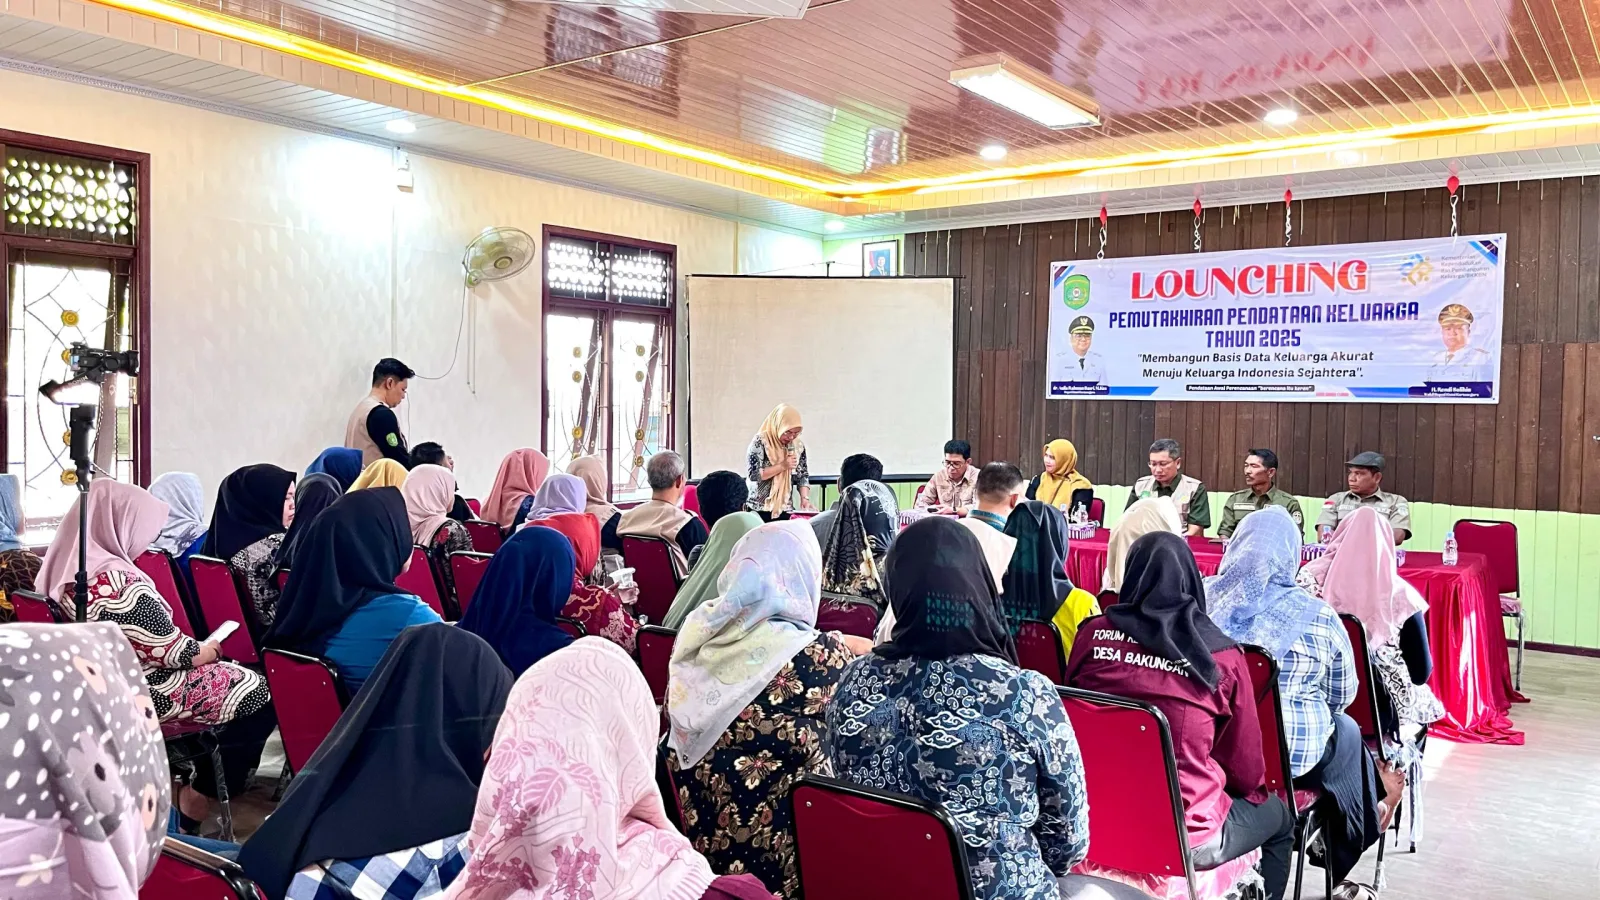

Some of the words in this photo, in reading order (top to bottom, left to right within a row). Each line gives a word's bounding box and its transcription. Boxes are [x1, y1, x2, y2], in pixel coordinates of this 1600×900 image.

[1131, 260, 1368, 300] LOUNCHING
[1109, 308, 1223, 328] PEMUTAKHIRAN
[1227, 305, 1322, 325] PENDATAAN
[1326, 301, 1419, 323] KELUARGA
[1205, 330, 1255, 348] TAHUN
[1259, 329, 1301, 347] 2025
[1137, 353, 1210, 365] "Membangun
[1213, 352, 1241, 362] Basis
[1244, 352, 1270, 362] Data
[1274, 352, 1328, 364] Keluarga
[1330, 351, 1374, 361] Akurat
[1142, 368, 1182, 380] Menuju
[1185, 367, 1235, 380] Keluarga
[1238, 368, 1294, 378] Indonesia
[1297, 367, 1363, 380] Sejahtera".
[1092, 629, 1125, 641] FORUM
[1093, 646, 1121, 662] DESA
